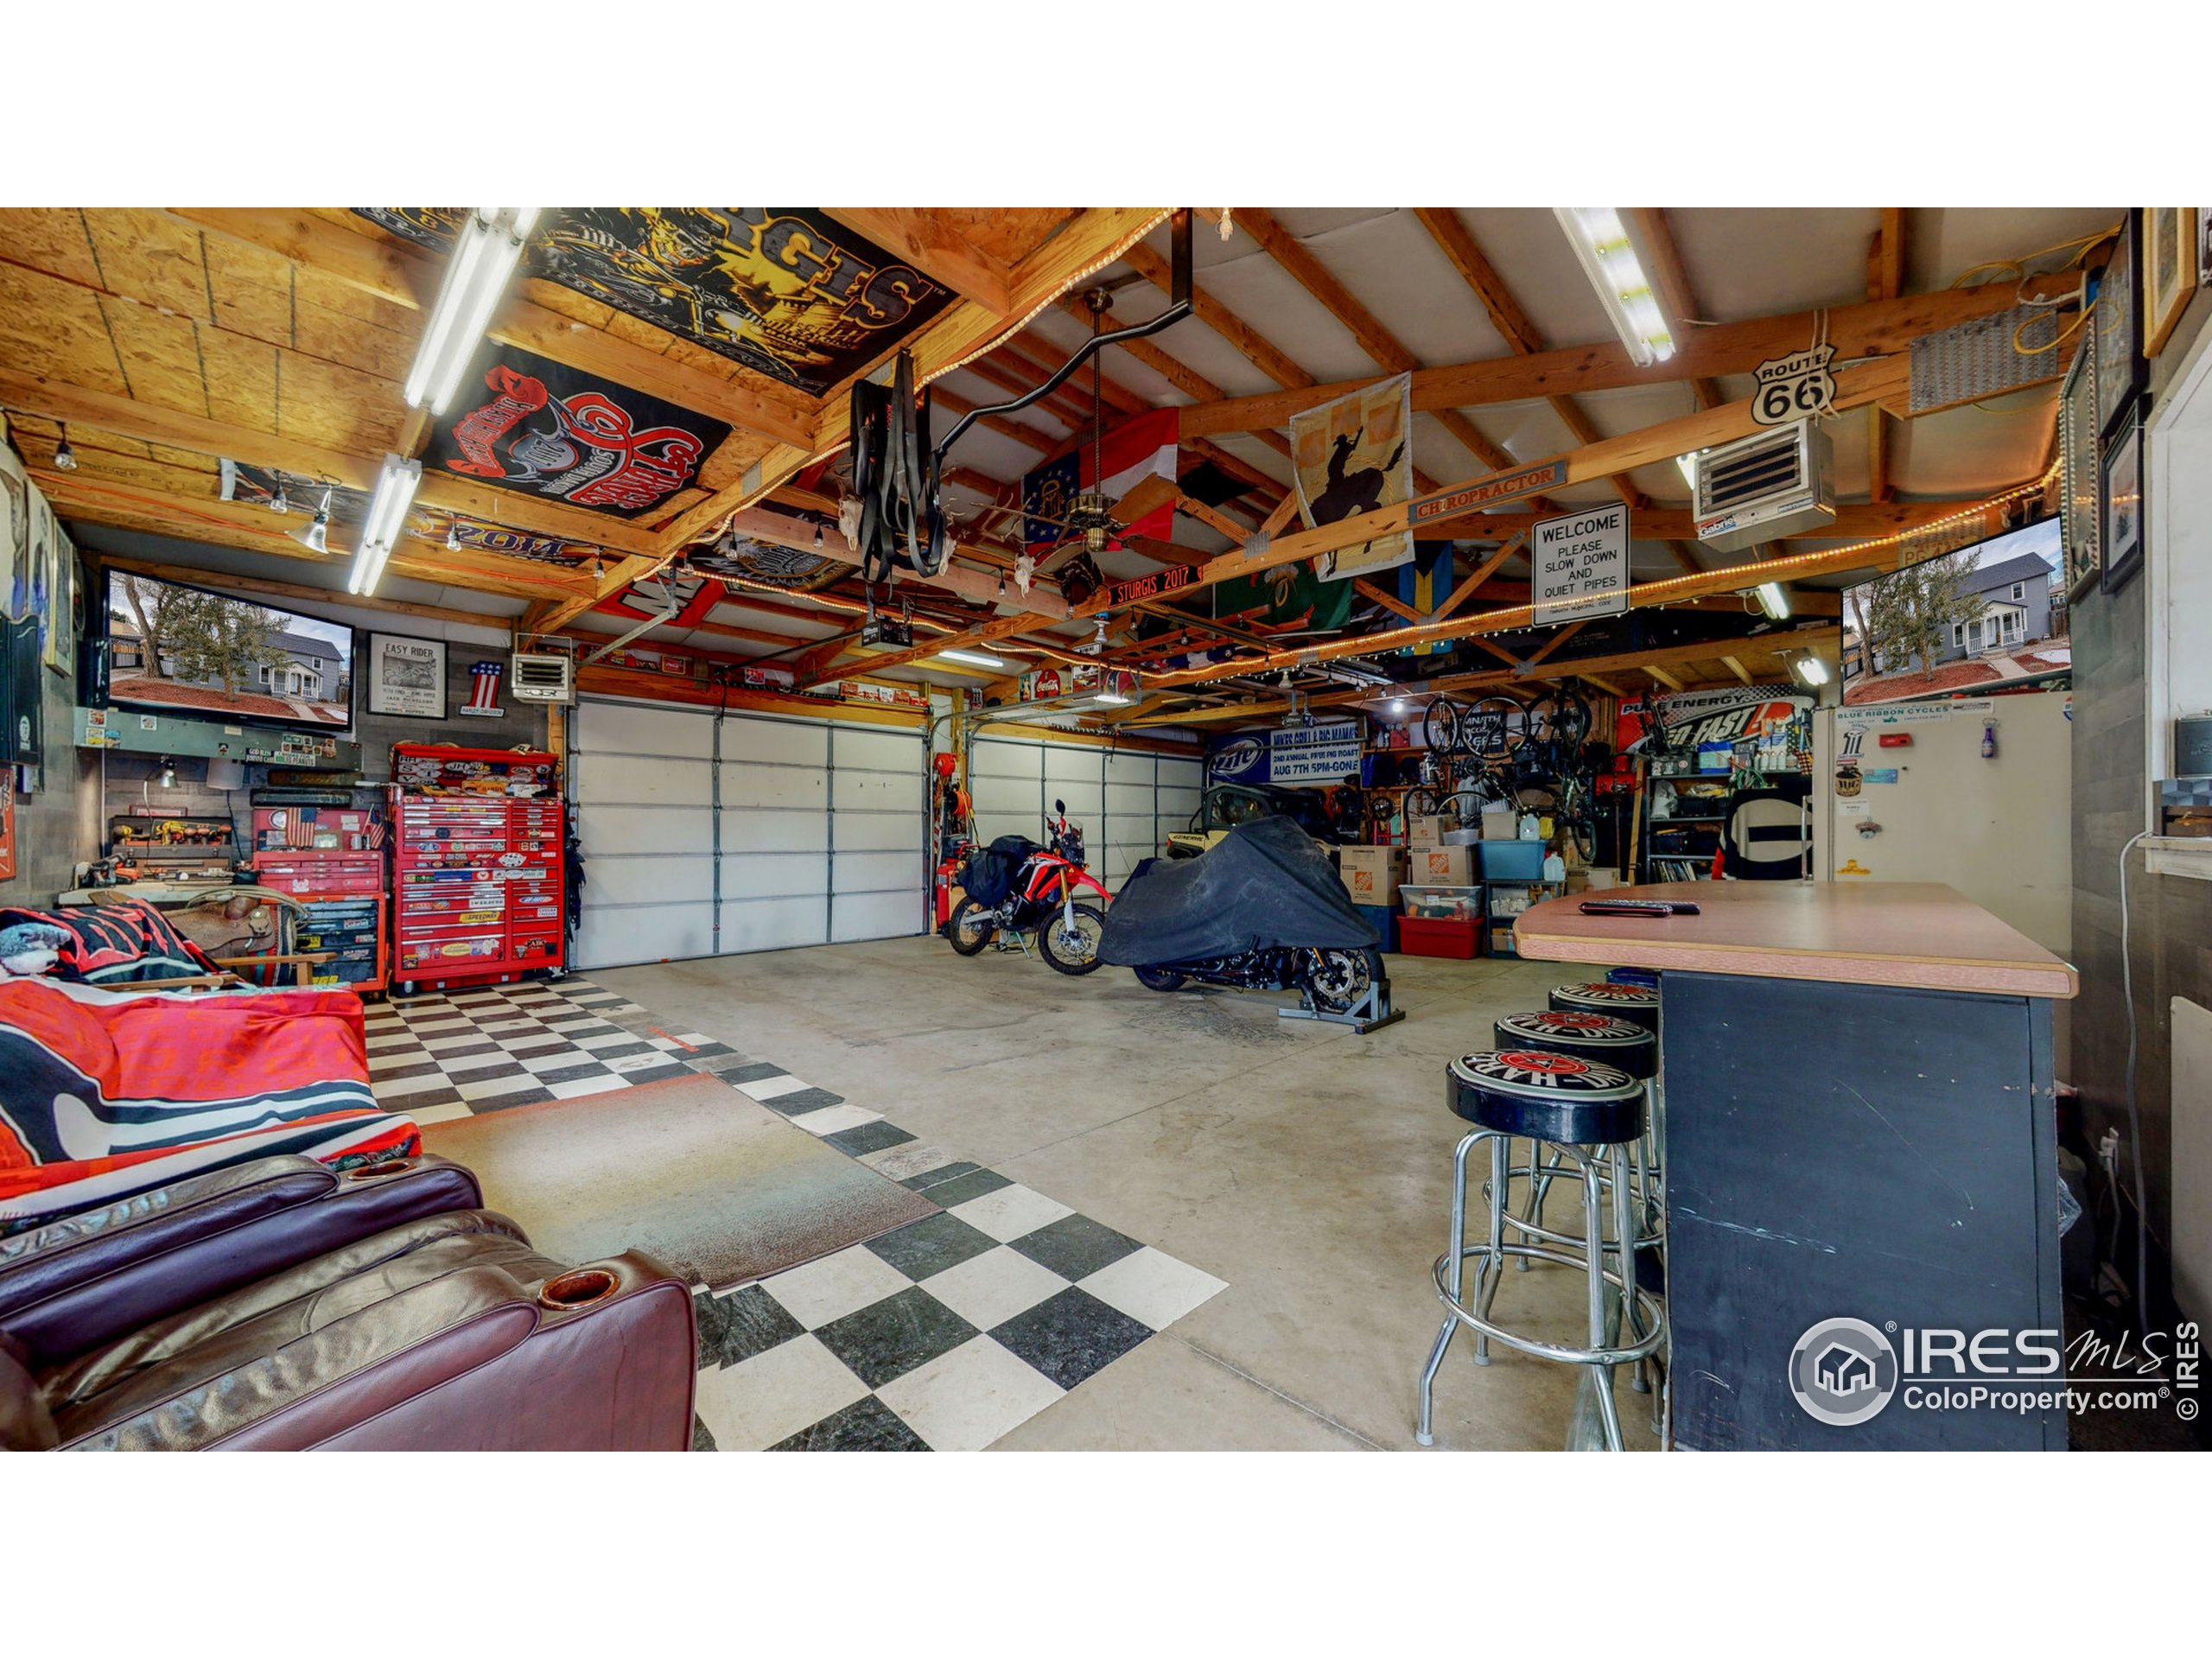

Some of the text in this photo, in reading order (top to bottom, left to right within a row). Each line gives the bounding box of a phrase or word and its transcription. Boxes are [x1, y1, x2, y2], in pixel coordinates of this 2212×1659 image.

[1762, 352, 1828, 379] ROUTE
[1763, 375, 1824, 419] 66
[576, 448, 617, 476] SOUTH
[1418, 469, 1554, 517] CHROPRACTOR
[1543, 513, 1619, 543] WELCOME
[1700, 514, 1737, 536] Gabriel
[457, 524, 567, 557] 2014
[1558, 540, 1602, 557] PLEASE
[1545, 550, 1618, 573] SLOW DOWN
[1117, 566, 1189, 603] STURGIS 2017
[1544, 576, 1618, 598] QUIET PIPES
[1567, 568, 1592, 582] AND
[385, 643, 434, 658] EASY RIDER
[1623, 695, 1745, 715] PUE ENERGY
[1693, 702, 1770, 745] FAST!
[1211, 747, 1254, 772] Lite
[1311, 751, 1325, 760] FREE
[1338, 748, 1359, 757] ROAST
[1274, 760, 1359, 776] AUG 7TH 5PM-GONE
